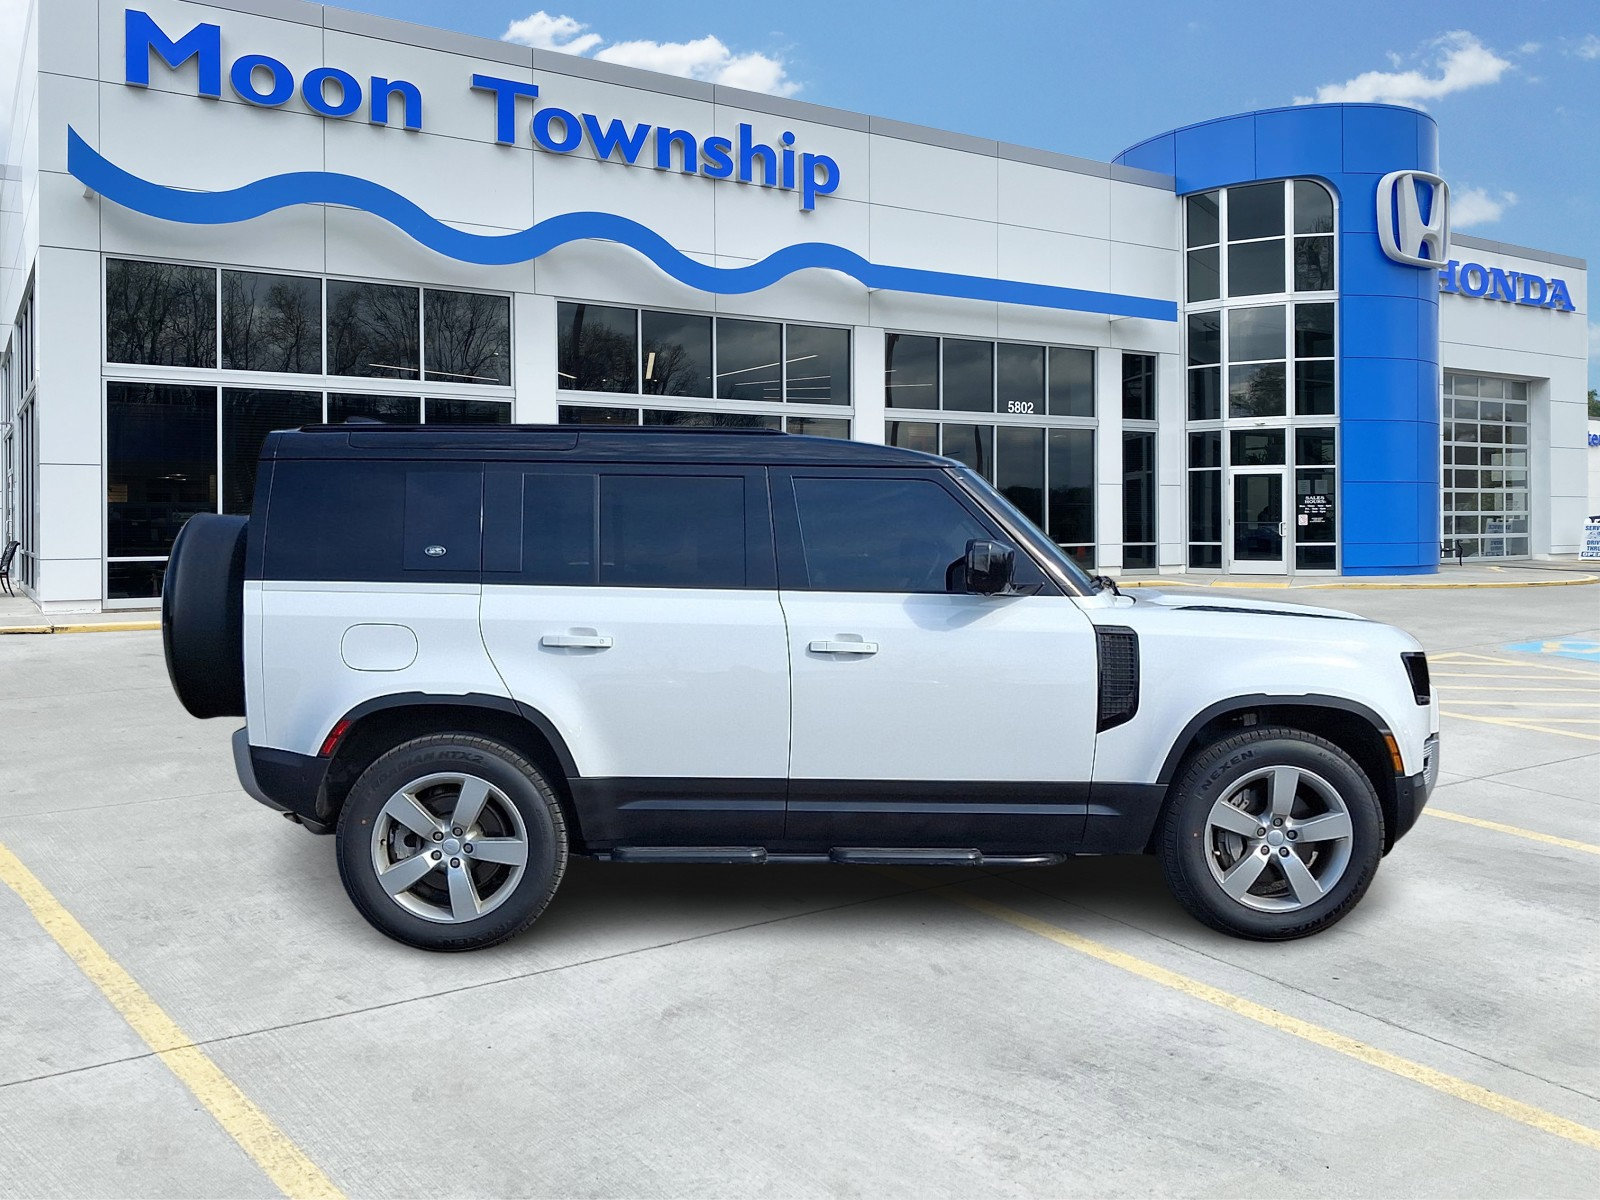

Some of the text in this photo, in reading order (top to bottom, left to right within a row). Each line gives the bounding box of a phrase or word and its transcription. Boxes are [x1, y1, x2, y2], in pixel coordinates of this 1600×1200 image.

[125, 9, 840, 212] Moon Township
[1439, 259, 1576, 312] HONDA
[1007, 400, 1034, 414] 5802
[1201, 750, 1254, 790] NEXEN
